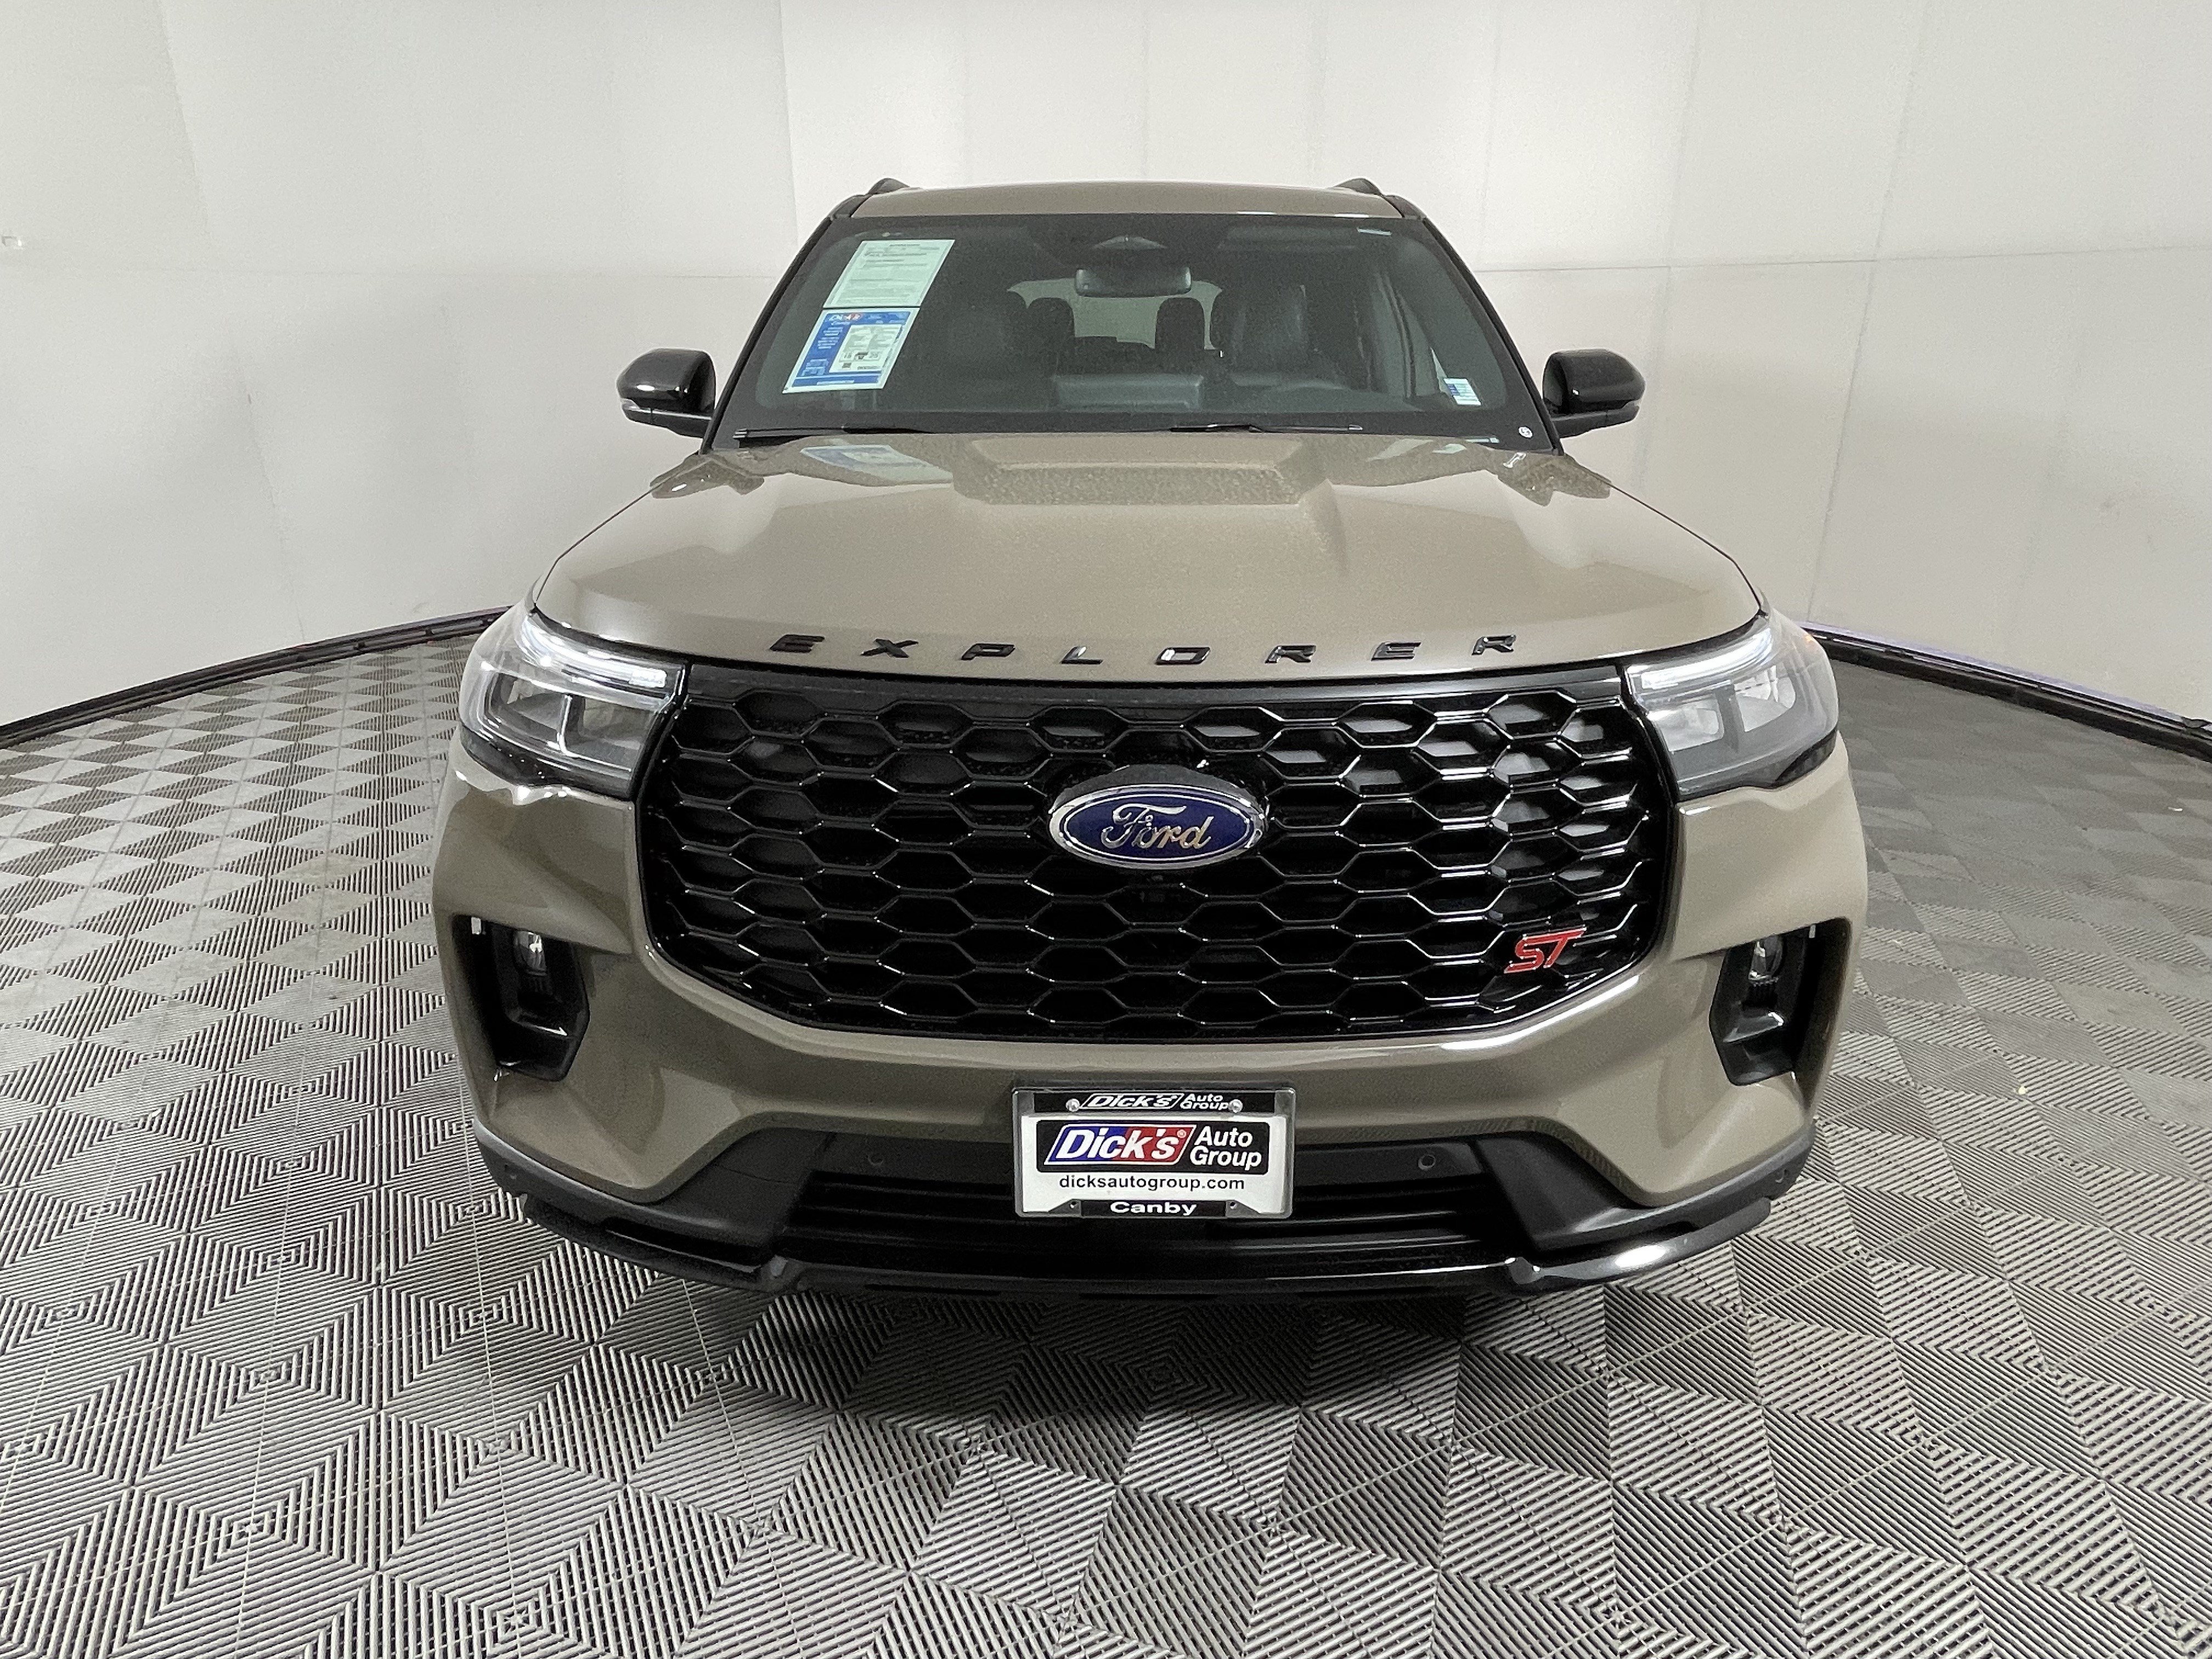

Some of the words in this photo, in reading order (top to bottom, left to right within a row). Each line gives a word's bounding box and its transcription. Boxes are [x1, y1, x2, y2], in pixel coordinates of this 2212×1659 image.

[769, 634, 1516, 665] EXPLORER
[1101, 803, 1215, 849] Ford
[1504, 927, 1587, 973] ST
[1087, 1095, 1173, 1107] Dick's
[1186, 1093, 1223, 1103] Auto
[1180, 1101, 1228, 1110] Group
[1056, 1127, 1180, 1160] Dick's
[1195, 1126, 1252, 1147] Auto
[1189, 1148, 1262, 1171] Group
[1059, 1175, 1245, 1192] dicksautogroup.com
[1109, 1201, 1197, 1216] Canby
